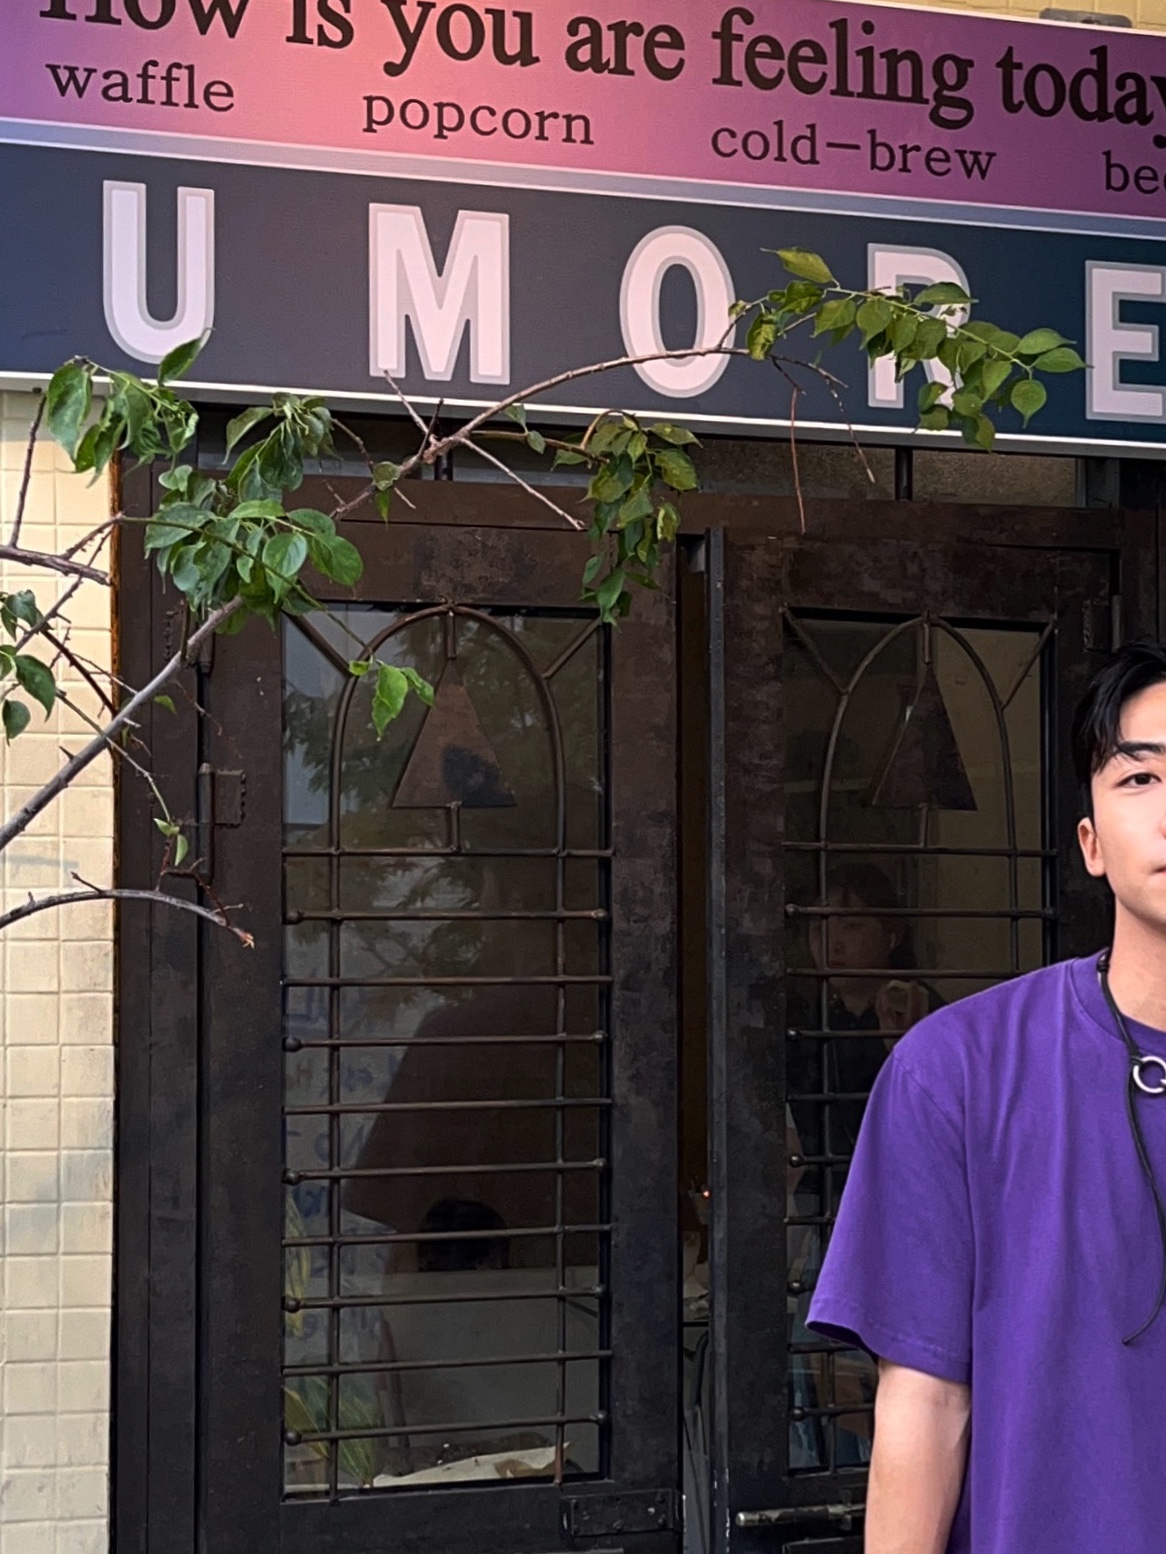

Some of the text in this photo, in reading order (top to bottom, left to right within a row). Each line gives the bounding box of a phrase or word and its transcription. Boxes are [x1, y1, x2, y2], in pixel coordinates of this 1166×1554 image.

[44, 58, 236, 112] waffle
[362, 94, 595, 146] popcorn
[711, 118, 998, 182] cold-brew
[381, 0, 541, 78] you
[564, 15, 686, 82] are
[711, 6, 977, 131] feeling
